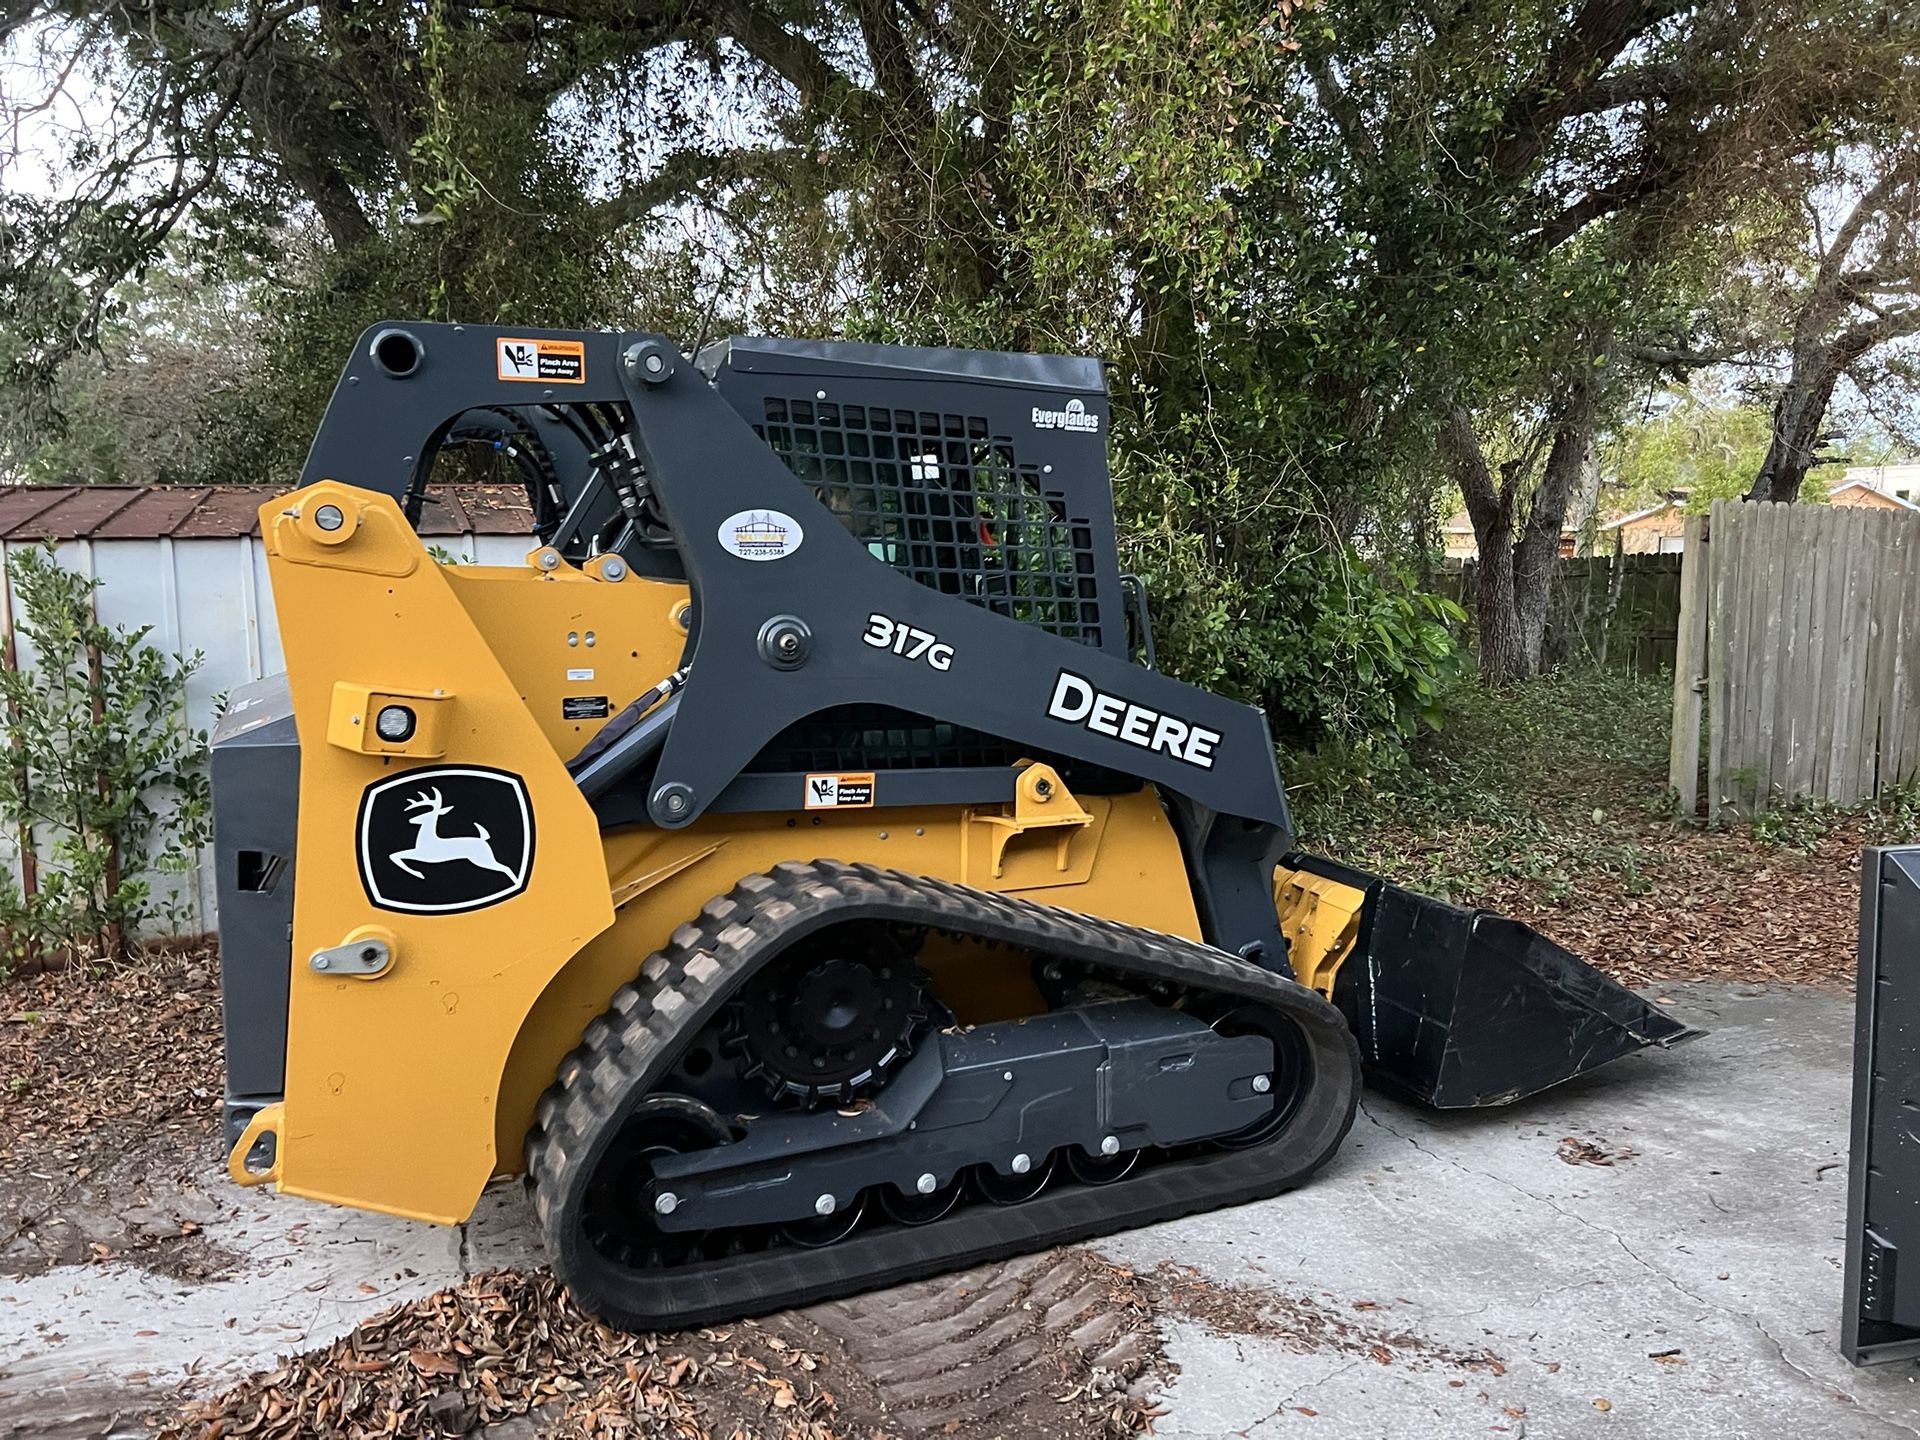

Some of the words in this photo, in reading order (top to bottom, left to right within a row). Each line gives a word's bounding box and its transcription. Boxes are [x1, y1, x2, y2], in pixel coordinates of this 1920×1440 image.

[540, 358, 560, 366] Pinch
[562, 359, 579, 367] Area
[1031, 407, 1099, 428] Everglades
[863, 614, 954, 671] 317G
[1049, 672, 1221, 768] DEERE
